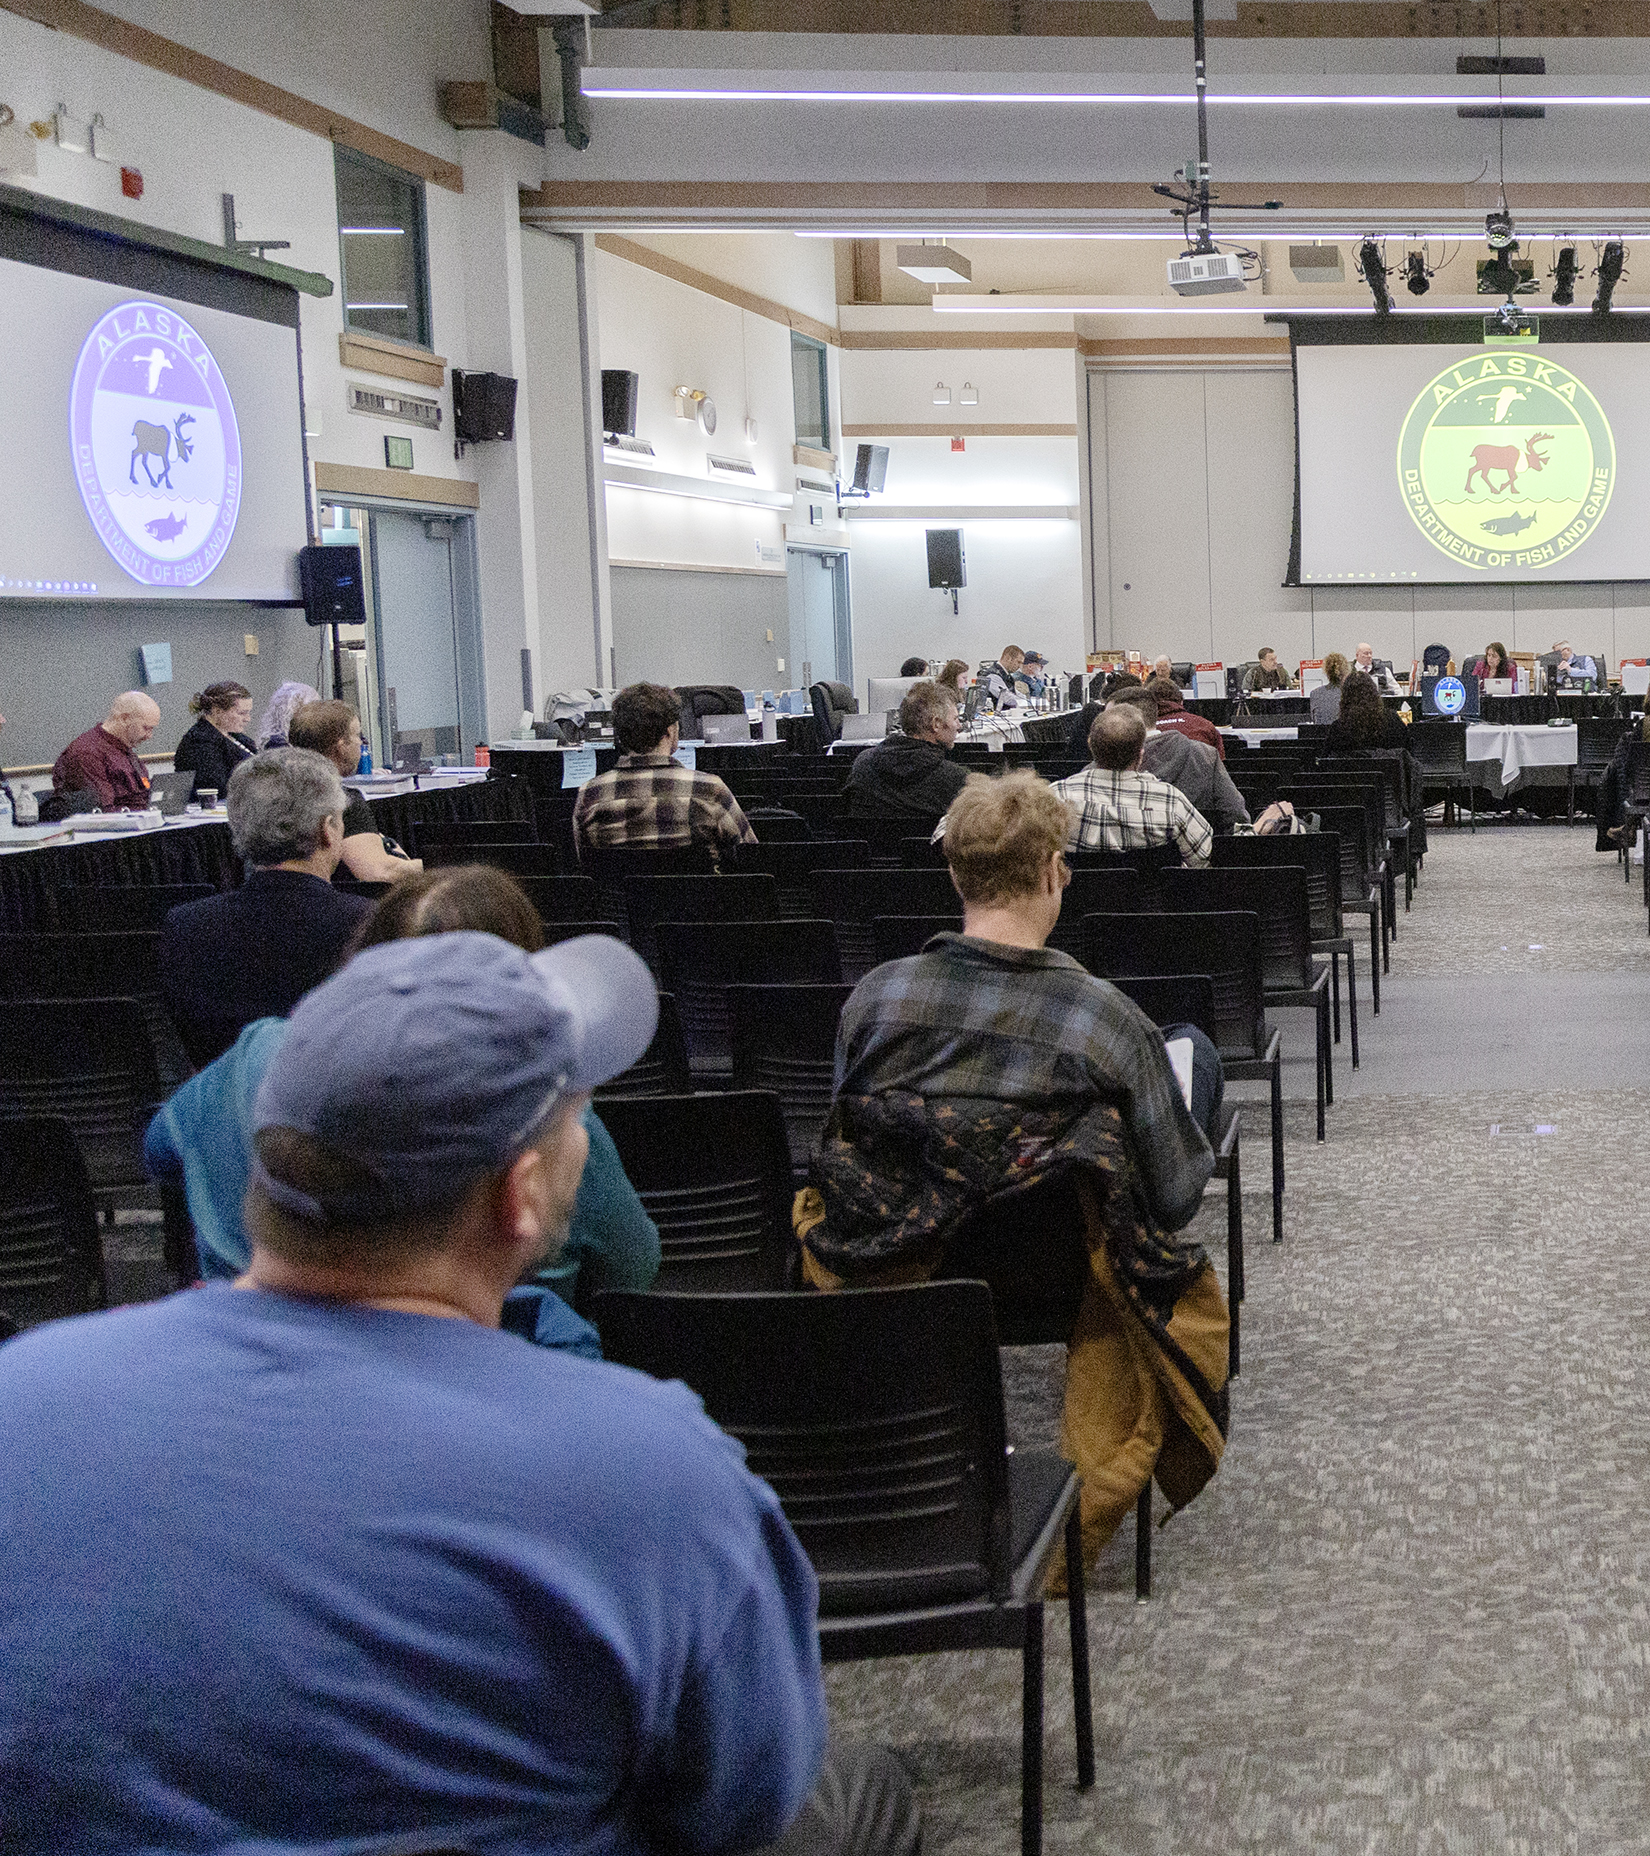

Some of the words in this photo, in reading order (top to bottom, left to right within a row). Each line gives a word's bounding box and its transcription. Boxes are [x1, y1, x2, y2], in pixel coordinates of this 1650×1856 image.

[97, 309, 210, 379] ALASKA
[1432, 357, 1578, 405] ALASKA
[79, 444, 149, 574] DEPARTMENT
[152, 563, 172, 582] OF
[173, 558, 203, 583] FISH
[203, 527, 226, 565] AND
[220, 464, 238, 524] GAME
[1404, 468, 1485, 562] DEPARTMENT
[1486, 552, 1512, 567] OF
[1516, 544, 1556, 567] FISH
[1556, 521, 1588, 552] AND
[1585, 467, 1609, 519] GAME
[1156, 718, 1177, 726] COACH
